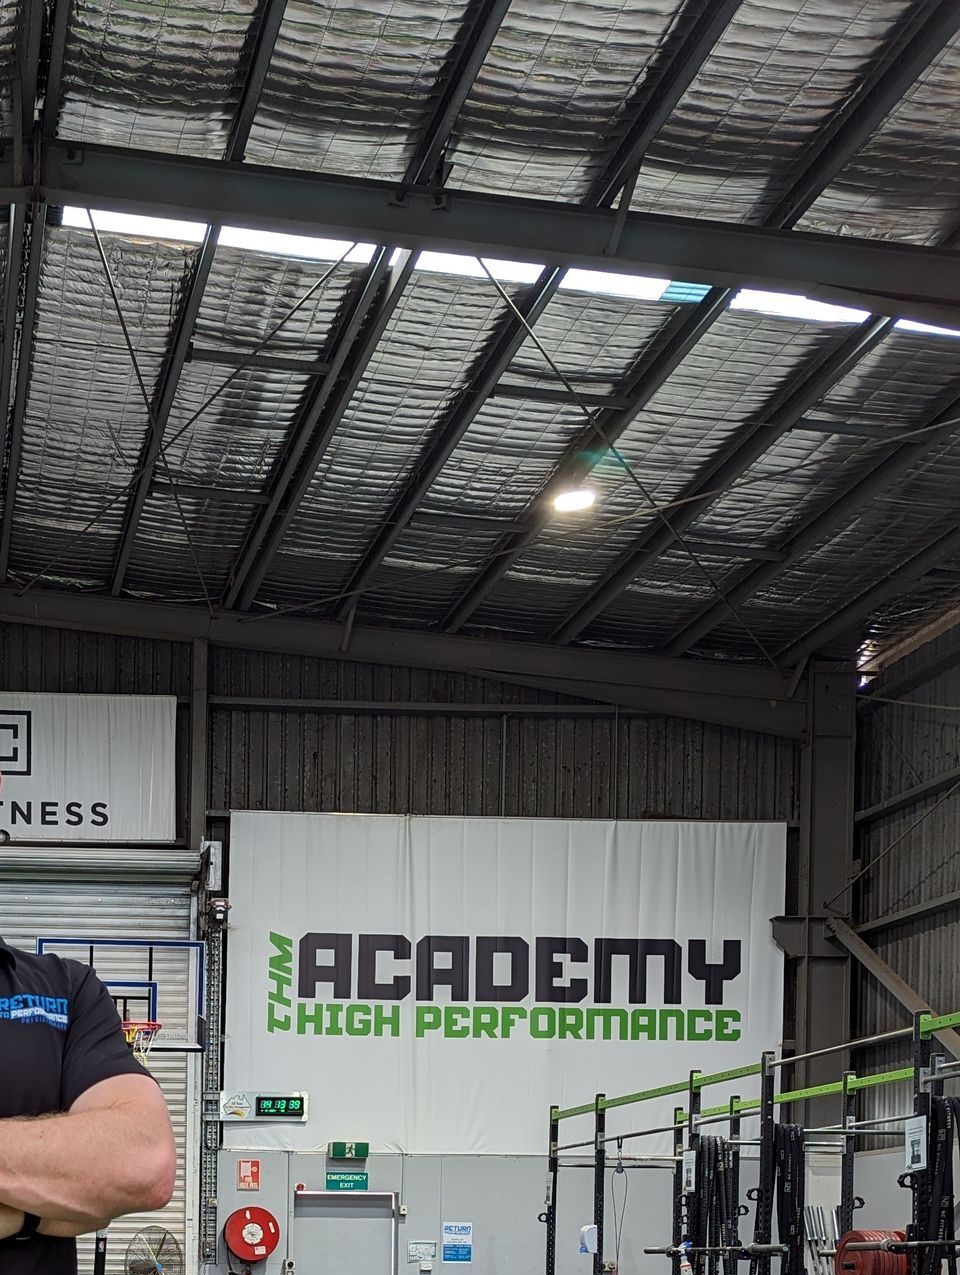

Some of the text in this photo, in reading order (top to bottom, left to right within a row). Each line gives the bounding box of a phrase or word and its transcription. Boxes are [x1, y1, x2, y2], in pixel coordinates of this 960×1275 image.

[297, 932, 742, 1005] ACADEMY
[297, 1003, 741, 1041] HIGH PERFORMANCE
